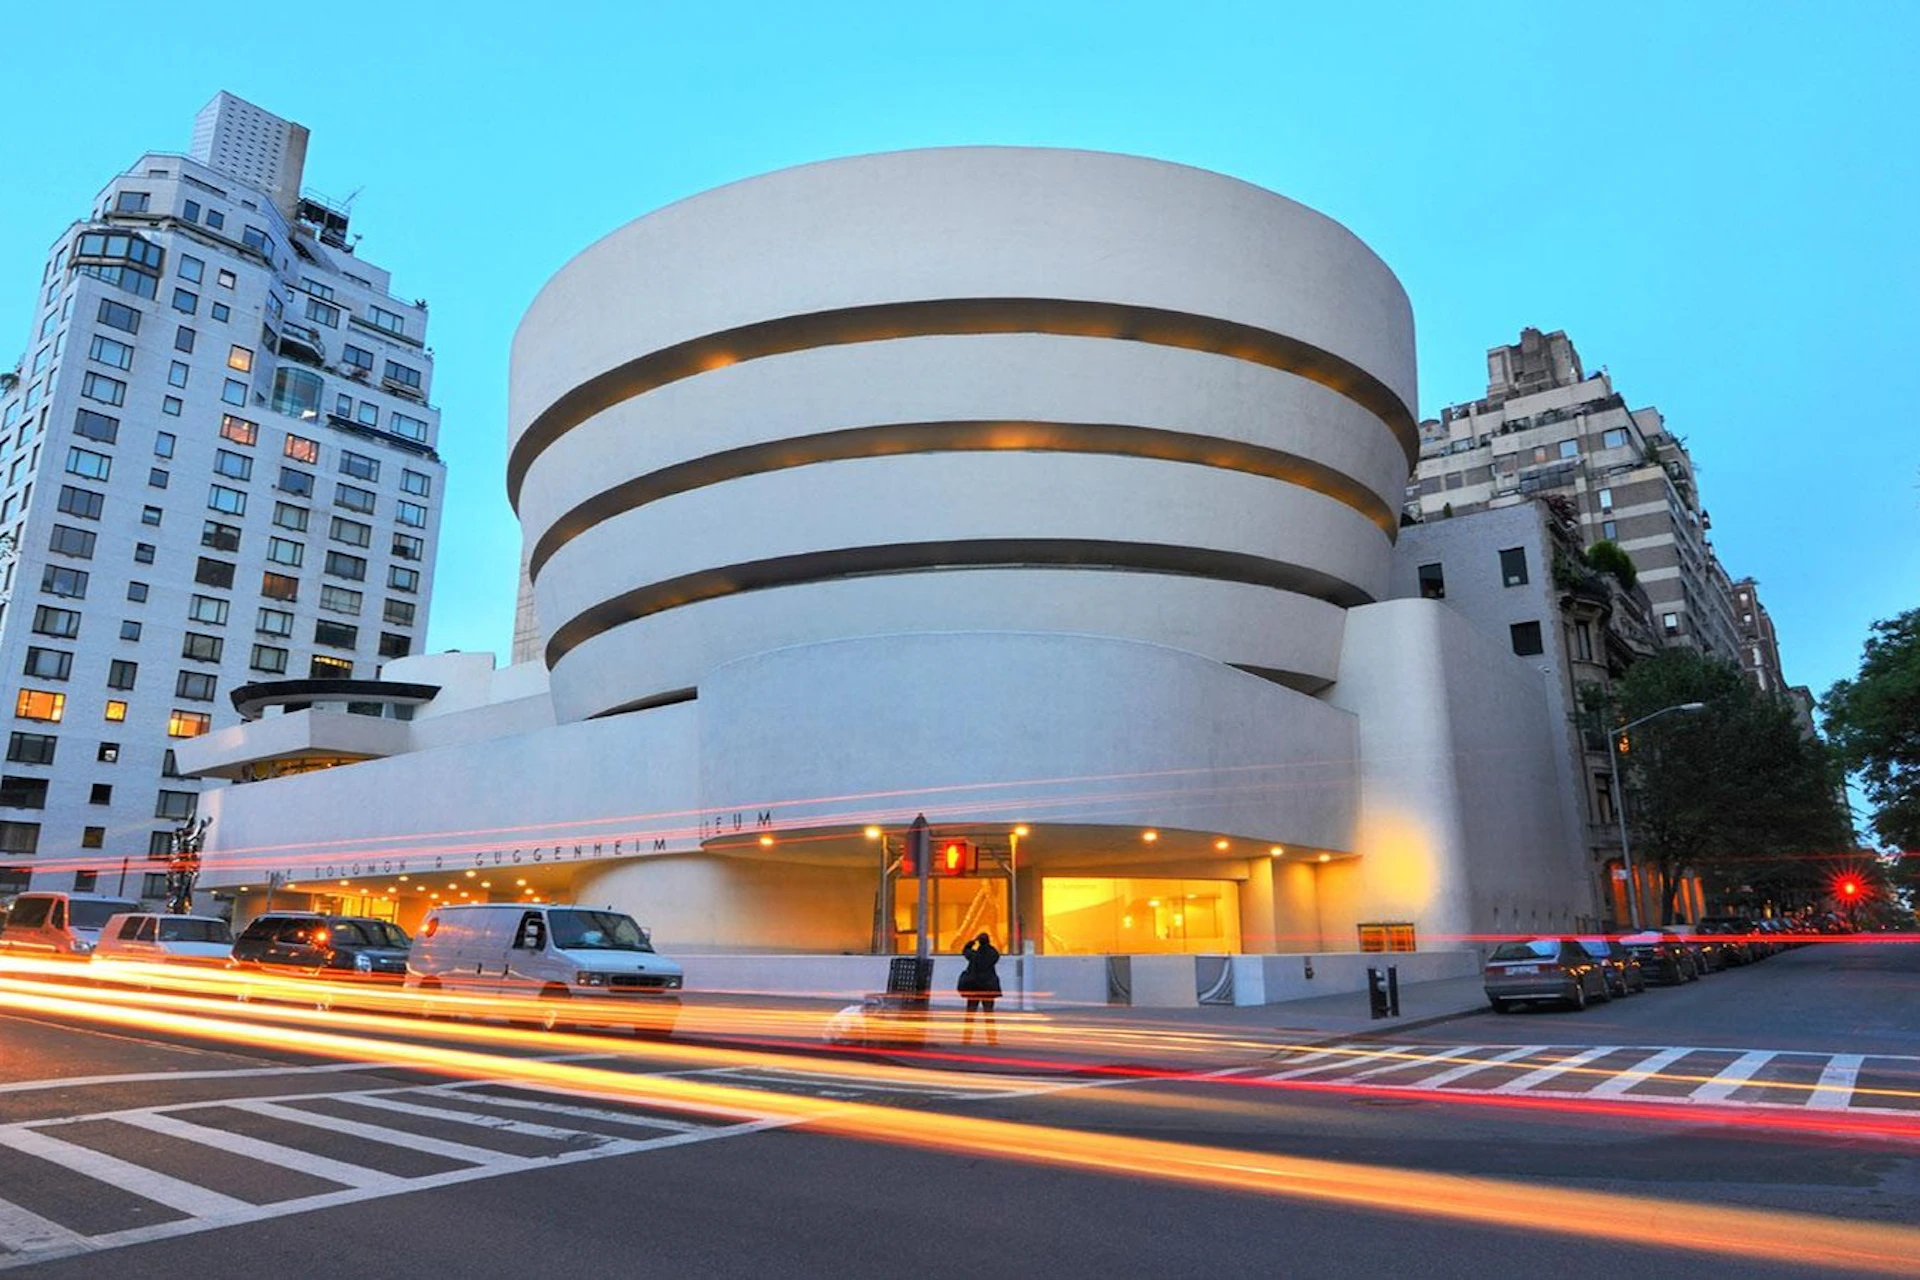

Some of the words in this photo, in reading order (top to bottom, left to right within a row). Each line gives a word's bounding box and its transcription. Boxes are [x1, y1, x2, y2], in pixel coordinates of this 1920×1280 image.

[264, 868, 292, 882] TE
[314, 859, 406, 878] SOLOMON
[475, 838, 667, 866] GUGGENHEIM
